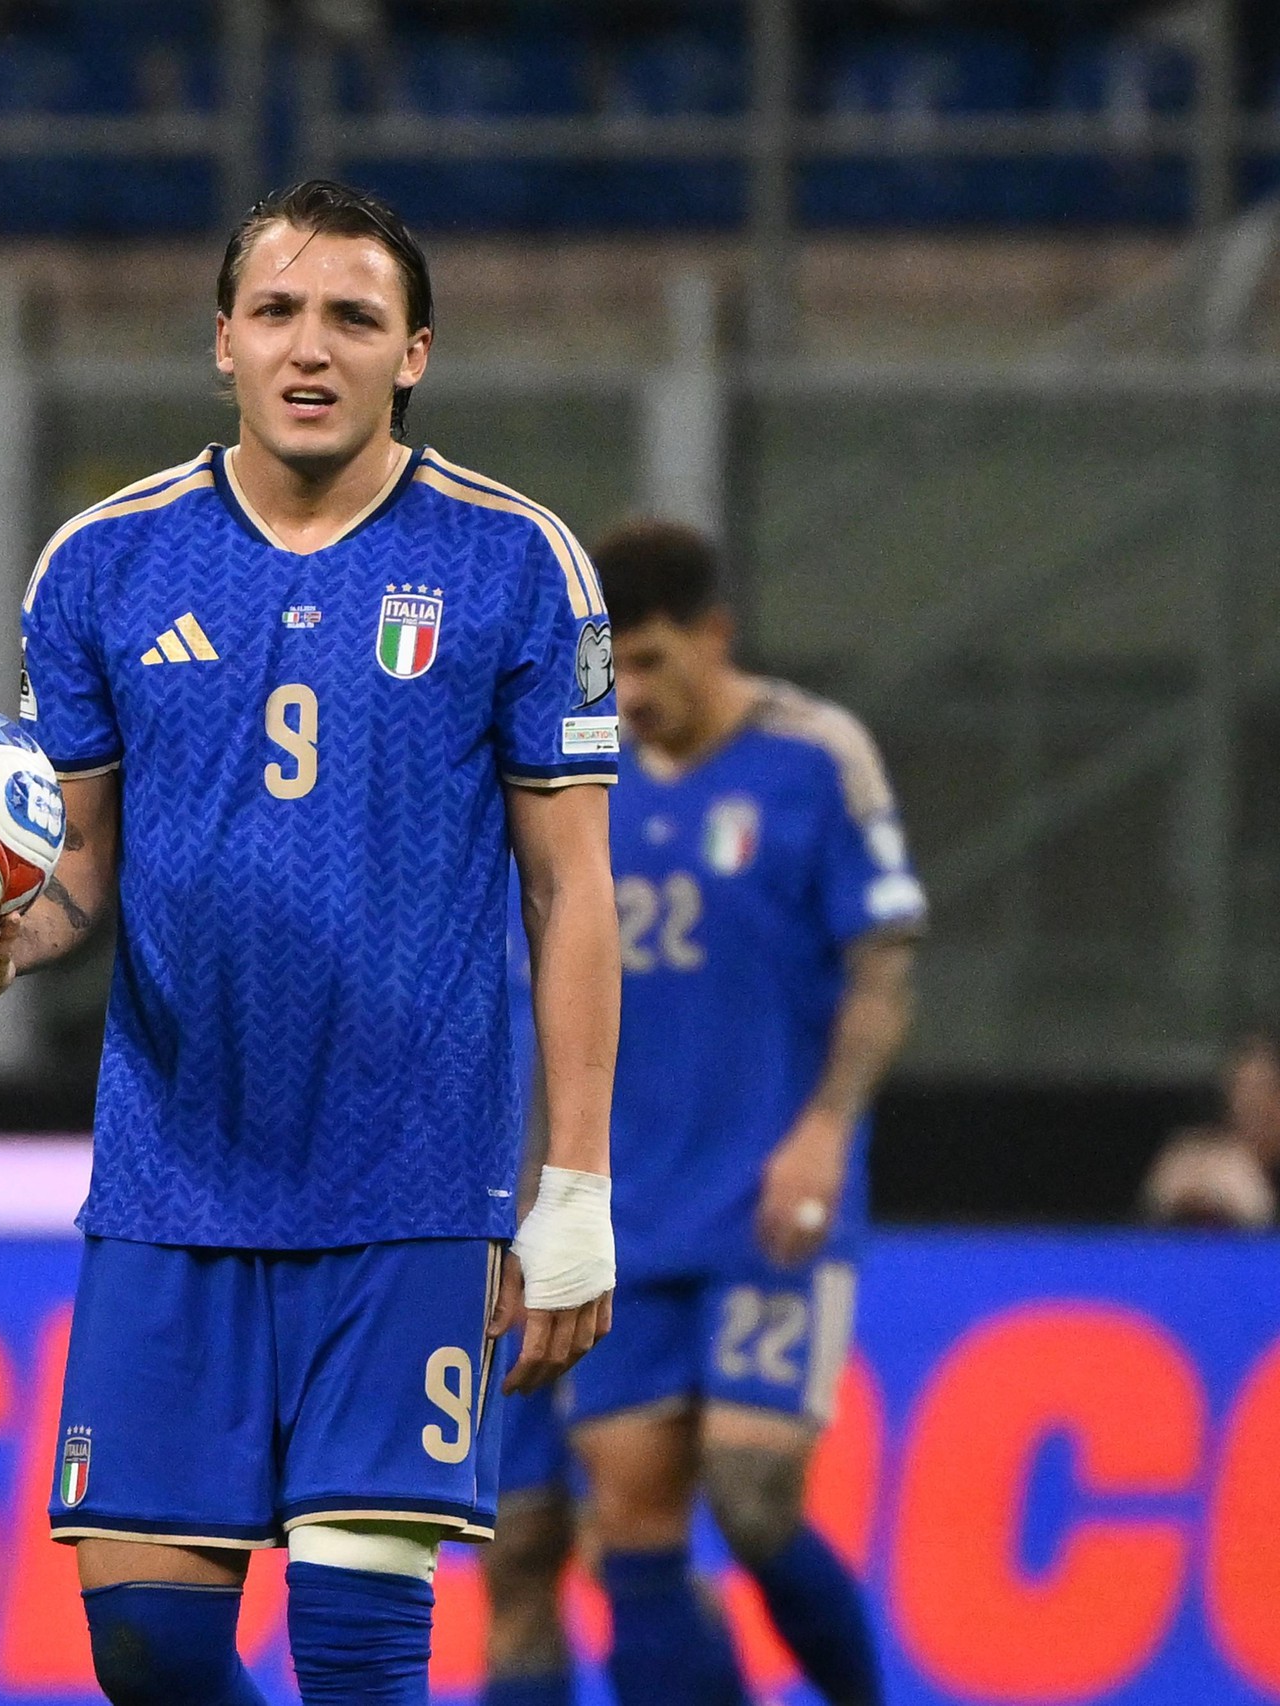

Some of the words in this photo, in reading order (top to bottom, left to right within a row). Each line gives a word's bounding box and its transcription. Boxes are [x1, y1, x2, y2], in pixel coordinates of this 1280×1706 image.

[385, 600, 436, 620] ITALIA
[264, 683, 319, 799] 9
[615, 874, 707, 971] 22
[716, 1285, 805, 1382] 22
[66, 1444, 88, 1457] ITALIA
[421, 1346, 472, 1463] 9
